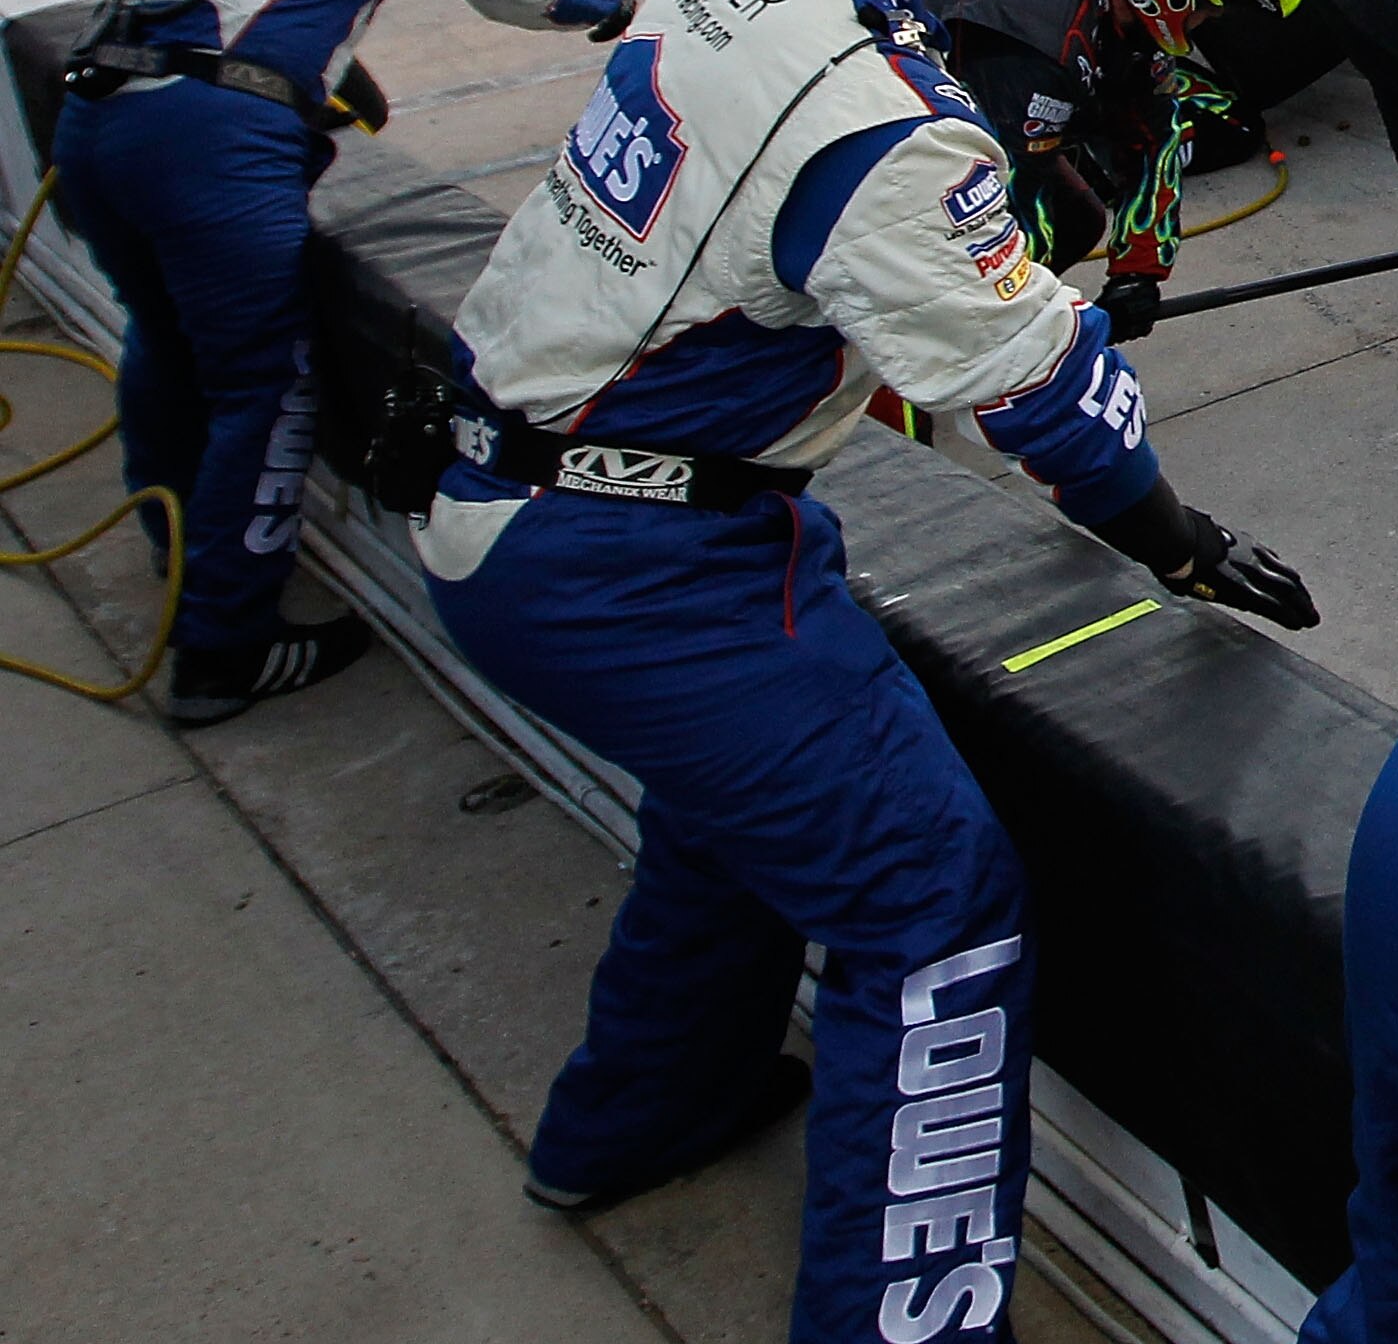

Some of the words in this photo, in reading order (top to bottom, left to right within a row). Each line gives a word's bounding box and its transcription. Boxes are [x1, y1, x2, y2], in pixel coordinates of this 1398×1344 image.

[574, 204, 648, 278] Together
[641, 485, 688, 504] WEAR
[878, 933, 1022, 1344] LOWE'S
